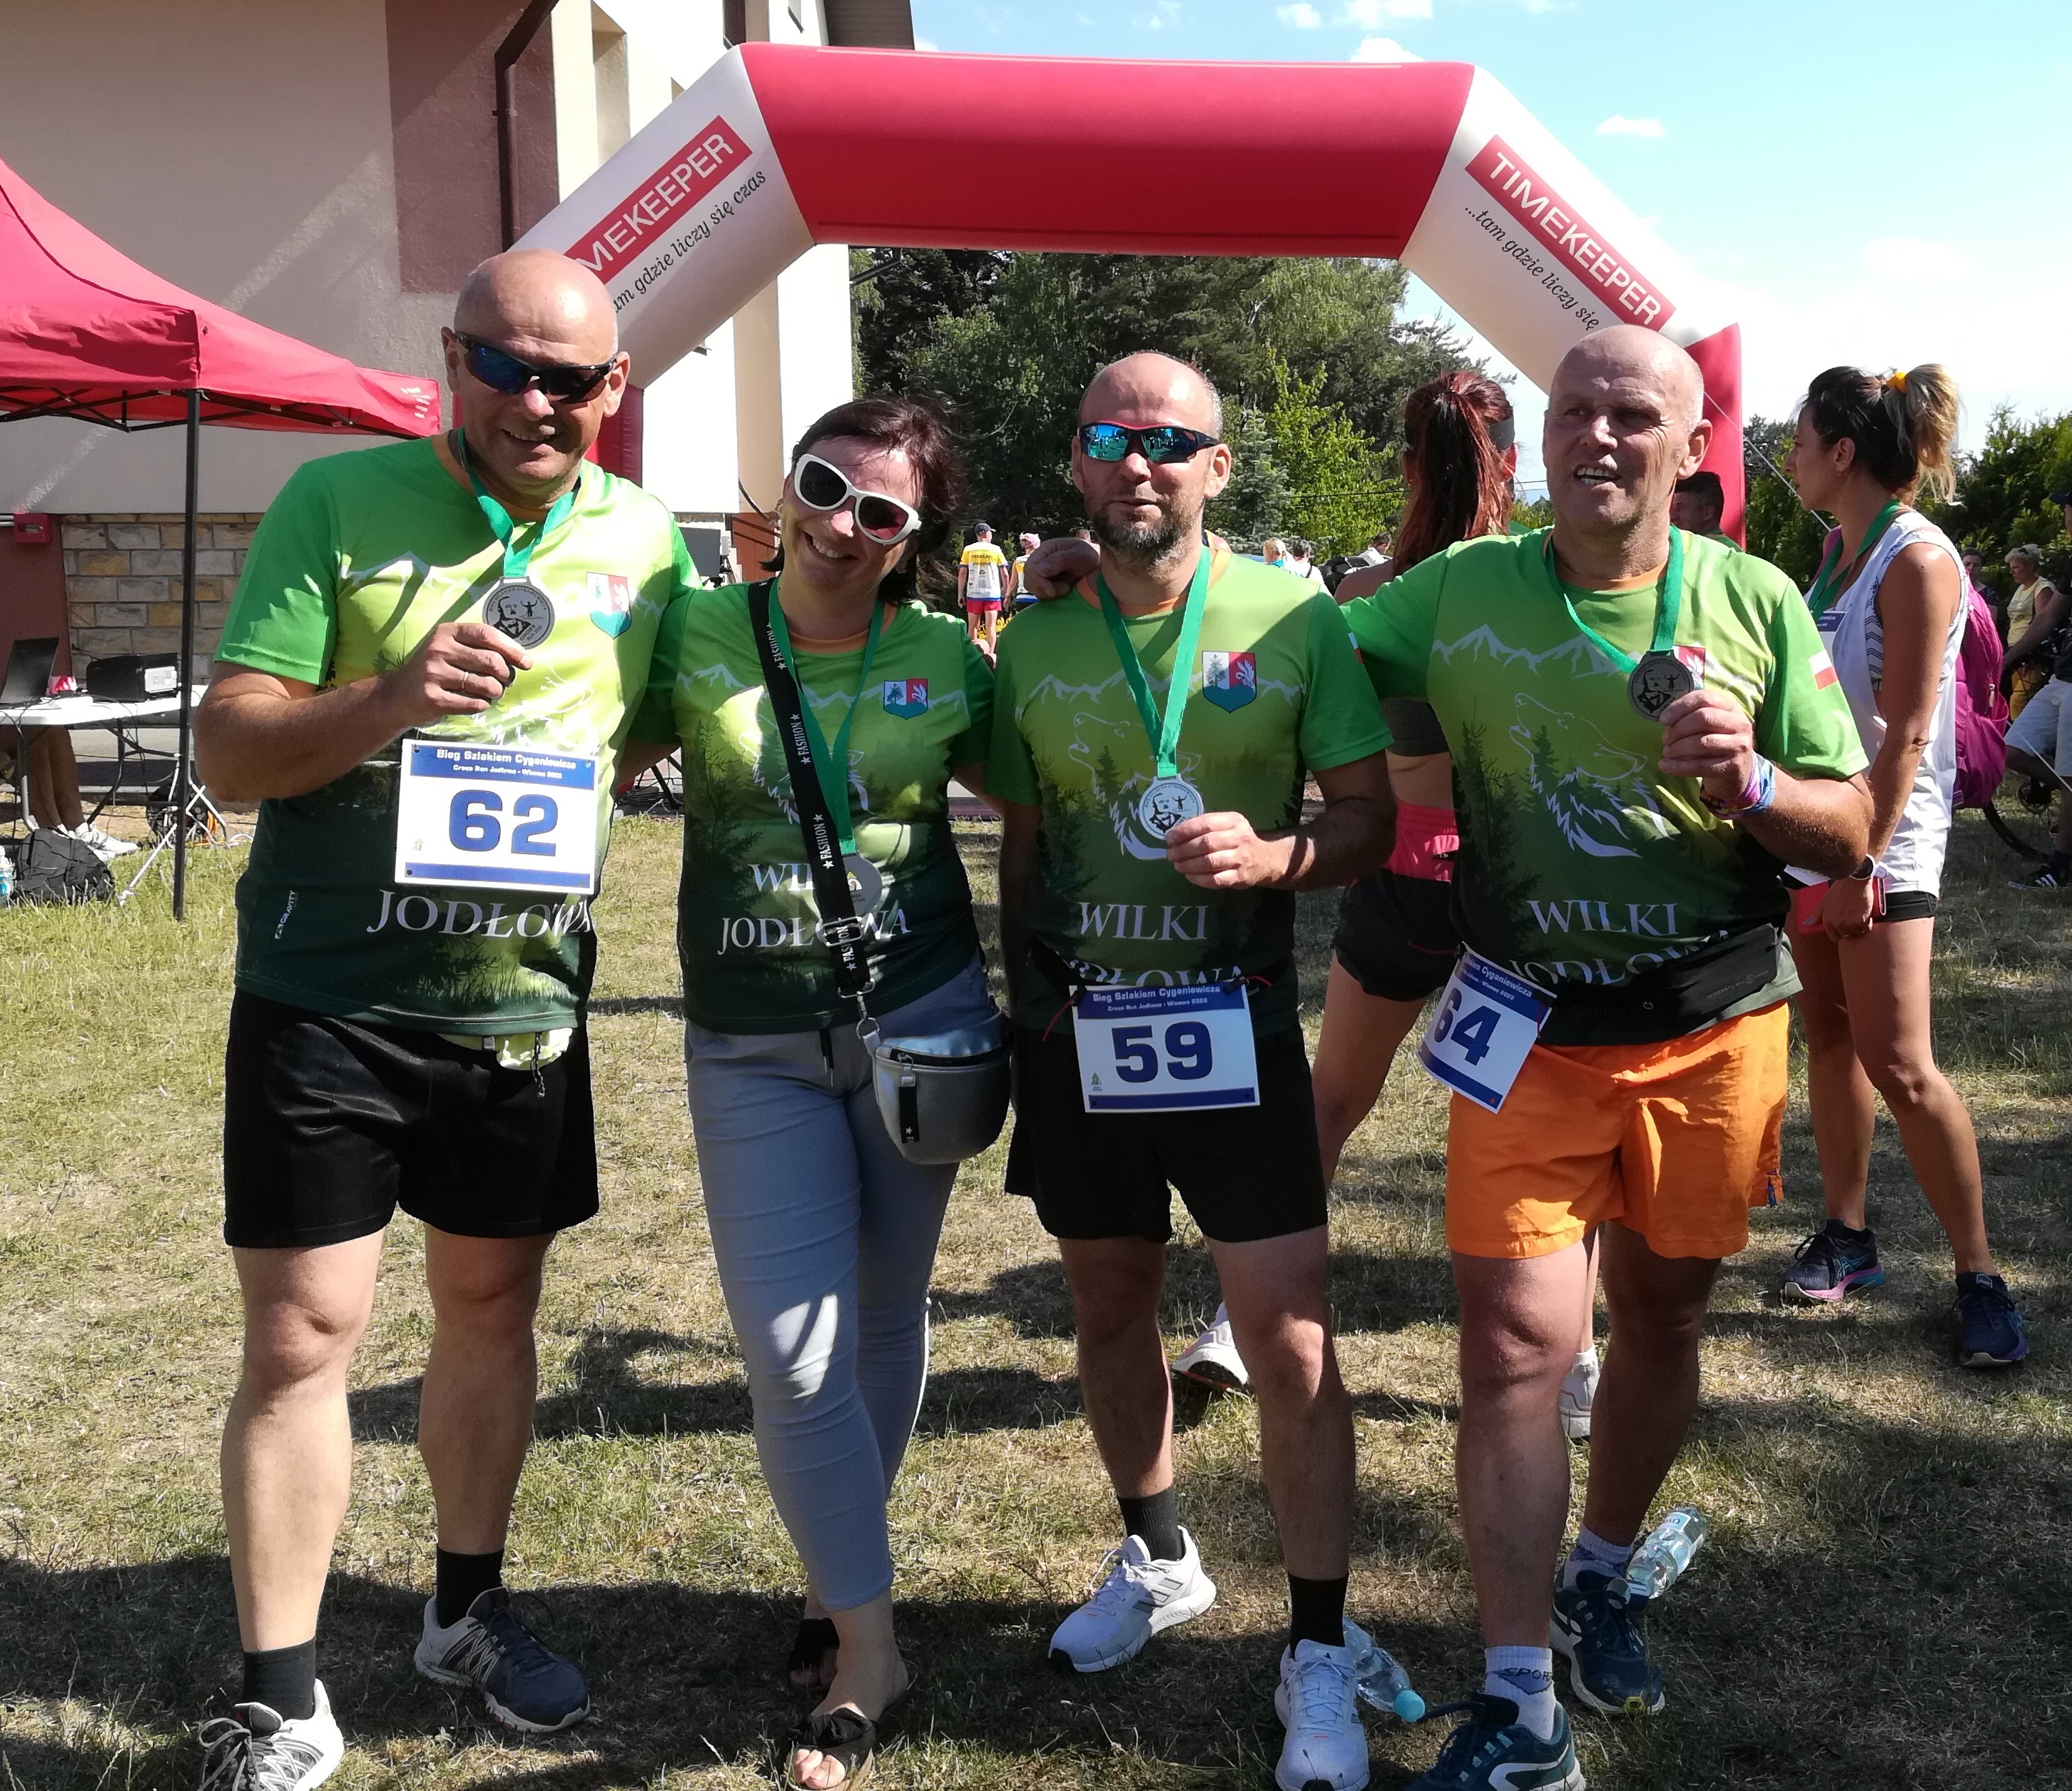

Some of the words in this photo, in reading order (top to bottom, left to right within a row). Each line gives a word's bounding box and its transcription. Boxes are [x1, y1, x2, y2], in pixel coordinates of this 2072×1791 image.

[575, 133, 733, 272] MEKEEPER
[635, 253, 674, 298] gdzie
[671, 222, 711, 258] liczy
[710, 202, 736, 225] się
[732, 171, 767, 204] czas
[1489, 152, 1662, 325] TIMEKEEPER
[1501, 240, 1545, 278] gdzie
[1541, 273, 1579, 310] liczy
[1575, 307, 1600, 331] się
[436, 748, 461, 761] Bieg
[464, 751, 512, 763] Szlakiem
[793, 721, 811, 756] FASHION
[449, 789, 559, 856] 62
[814, 821, 833, 861] FASHION
[366, 888, 592, 939] JODŁOWA
[1077, 901, 1209, 941] WILKI
[1525, 899, 1681, 936] WILKI
[1092, 993, 1112, 1003] Bieg
[1114, 988, 1157, 1001] Szlakiem
[1159, 985, 1221, 999] Cyganiewicza
[1481, 966, 1533, 998] Cyganiewicza
[1111, 1020, 1214, 1083] 59
[1433, 987, 1502, 1067] 64
